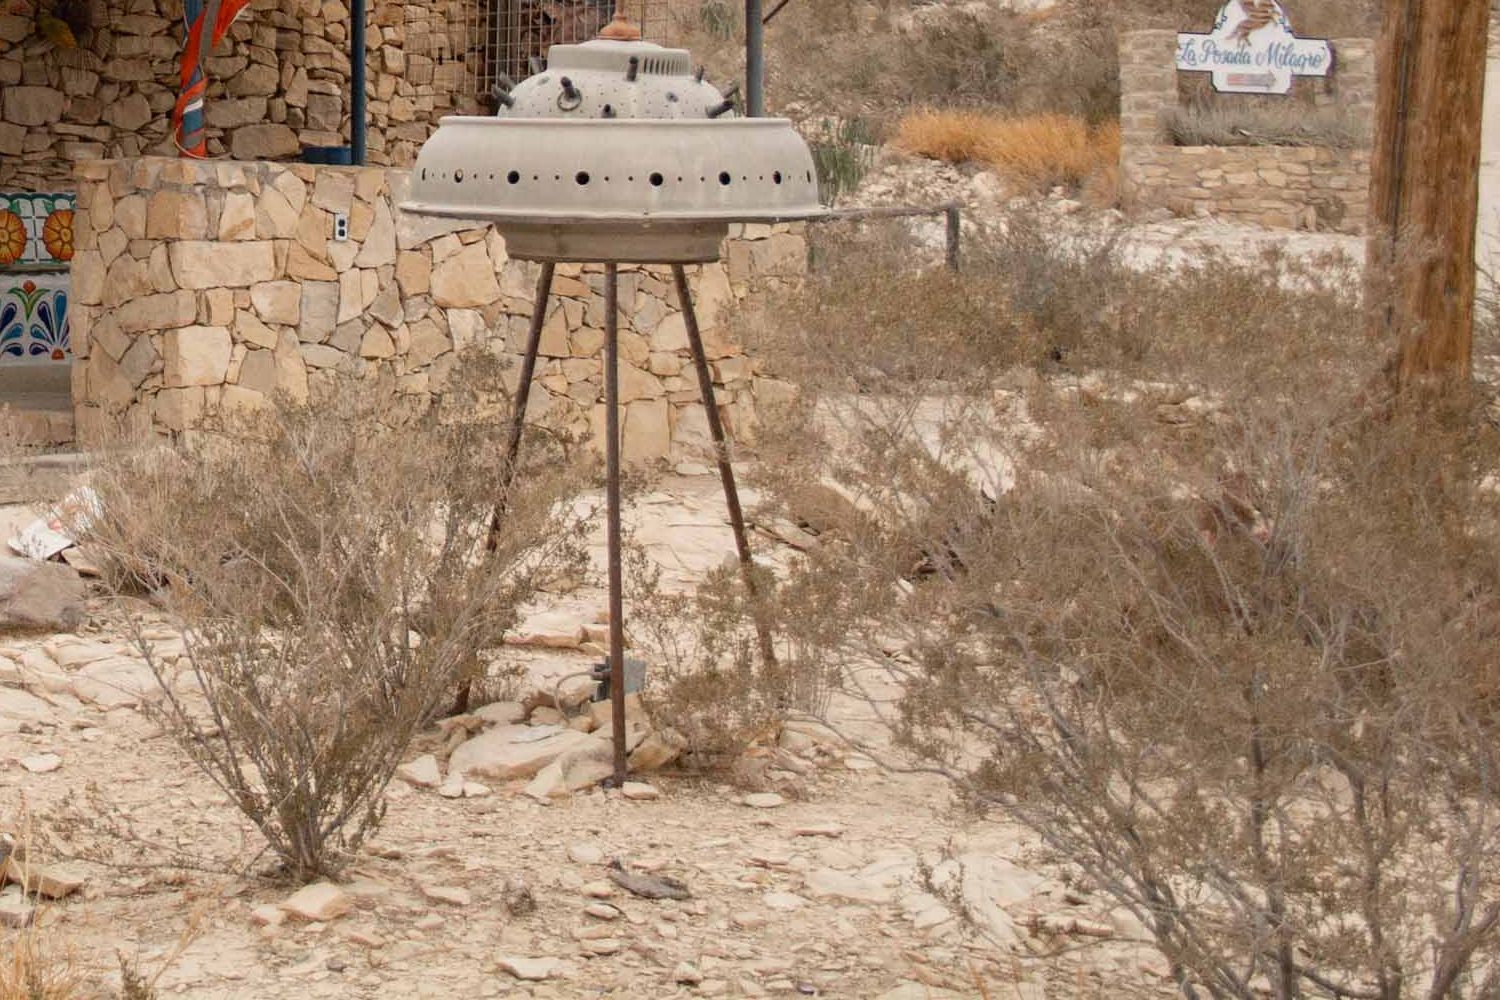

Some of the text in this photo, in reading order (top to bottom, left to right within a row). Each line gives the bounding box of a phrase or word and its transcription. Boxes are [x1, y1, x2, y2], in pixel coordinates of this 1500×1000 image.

[1179, 38, 1323, 71] La Posada Milagro
